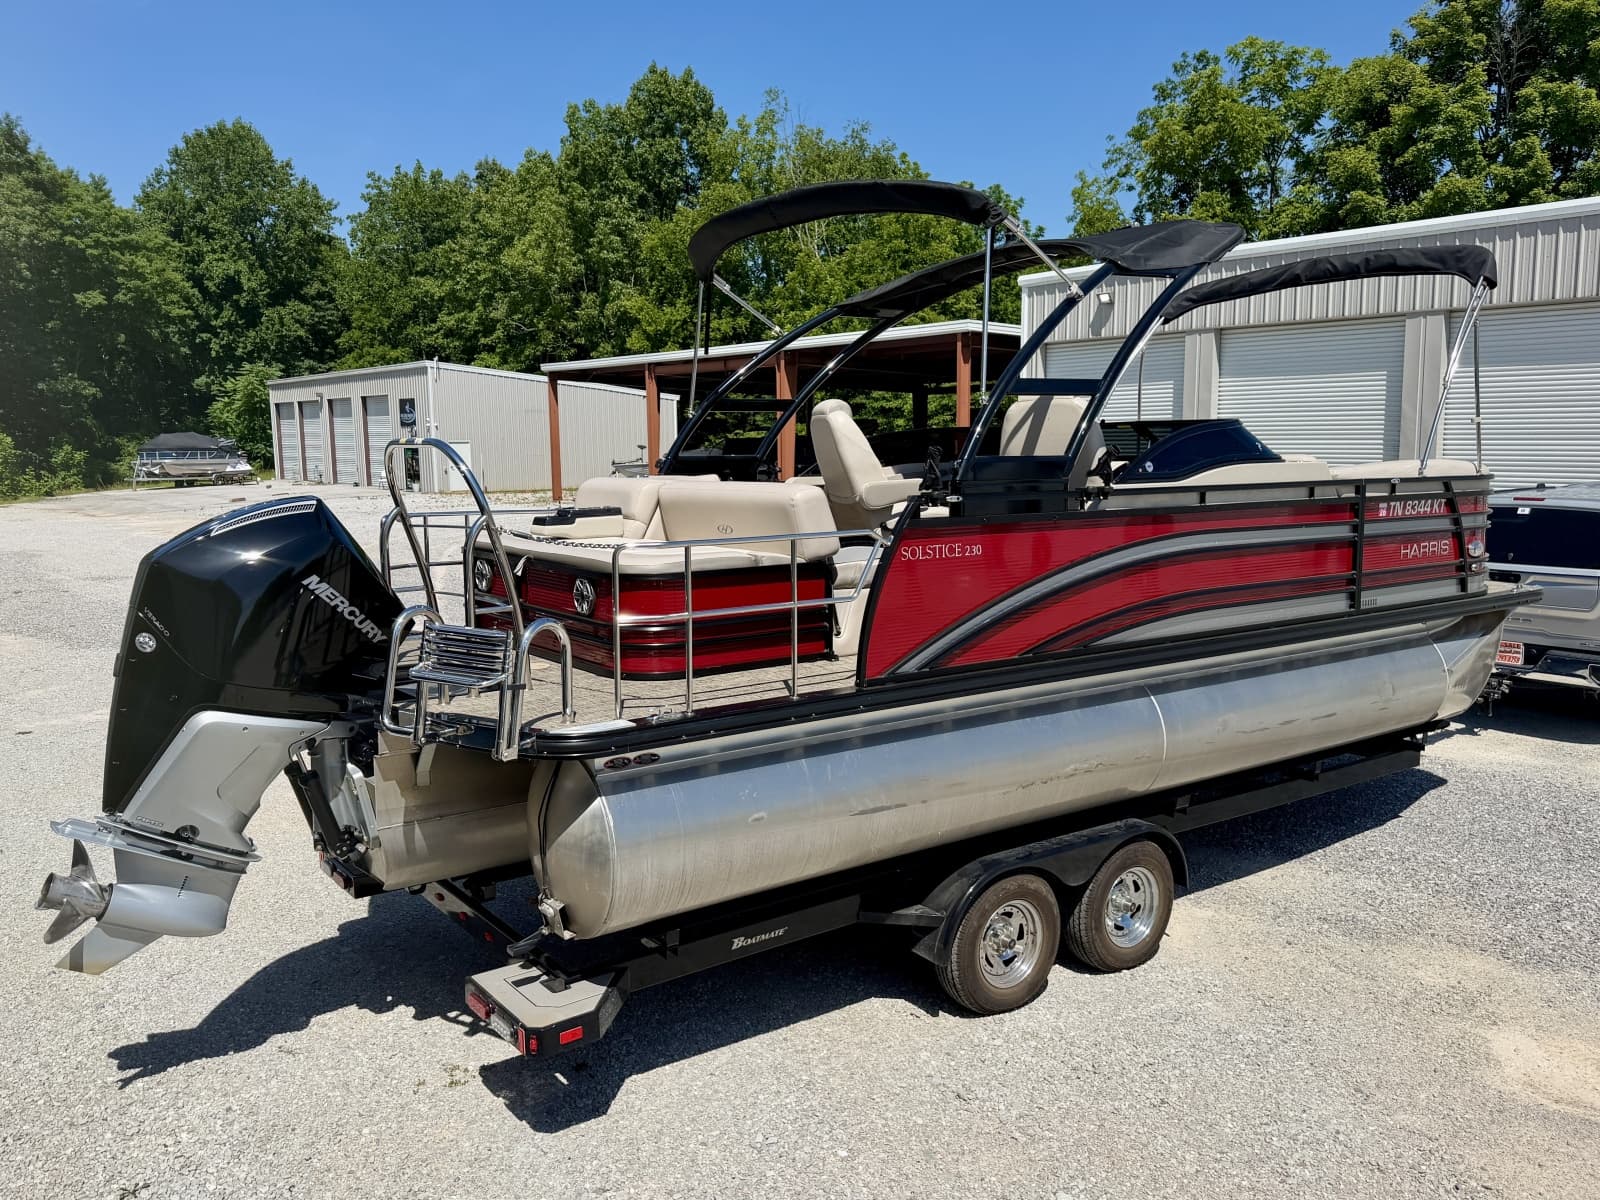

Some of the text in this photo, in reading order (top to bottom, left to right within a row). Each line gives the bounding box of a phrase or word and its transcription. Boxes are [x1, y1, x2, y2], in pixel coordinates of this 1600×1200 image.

[1389, 498, 1446, 517] TN 8344 KT
[901, 543, 982, 561] SOLSTICE 230
[1400, 540, 1450, 560] HARRIS
[301, 574, 389, 644] MERCURY
